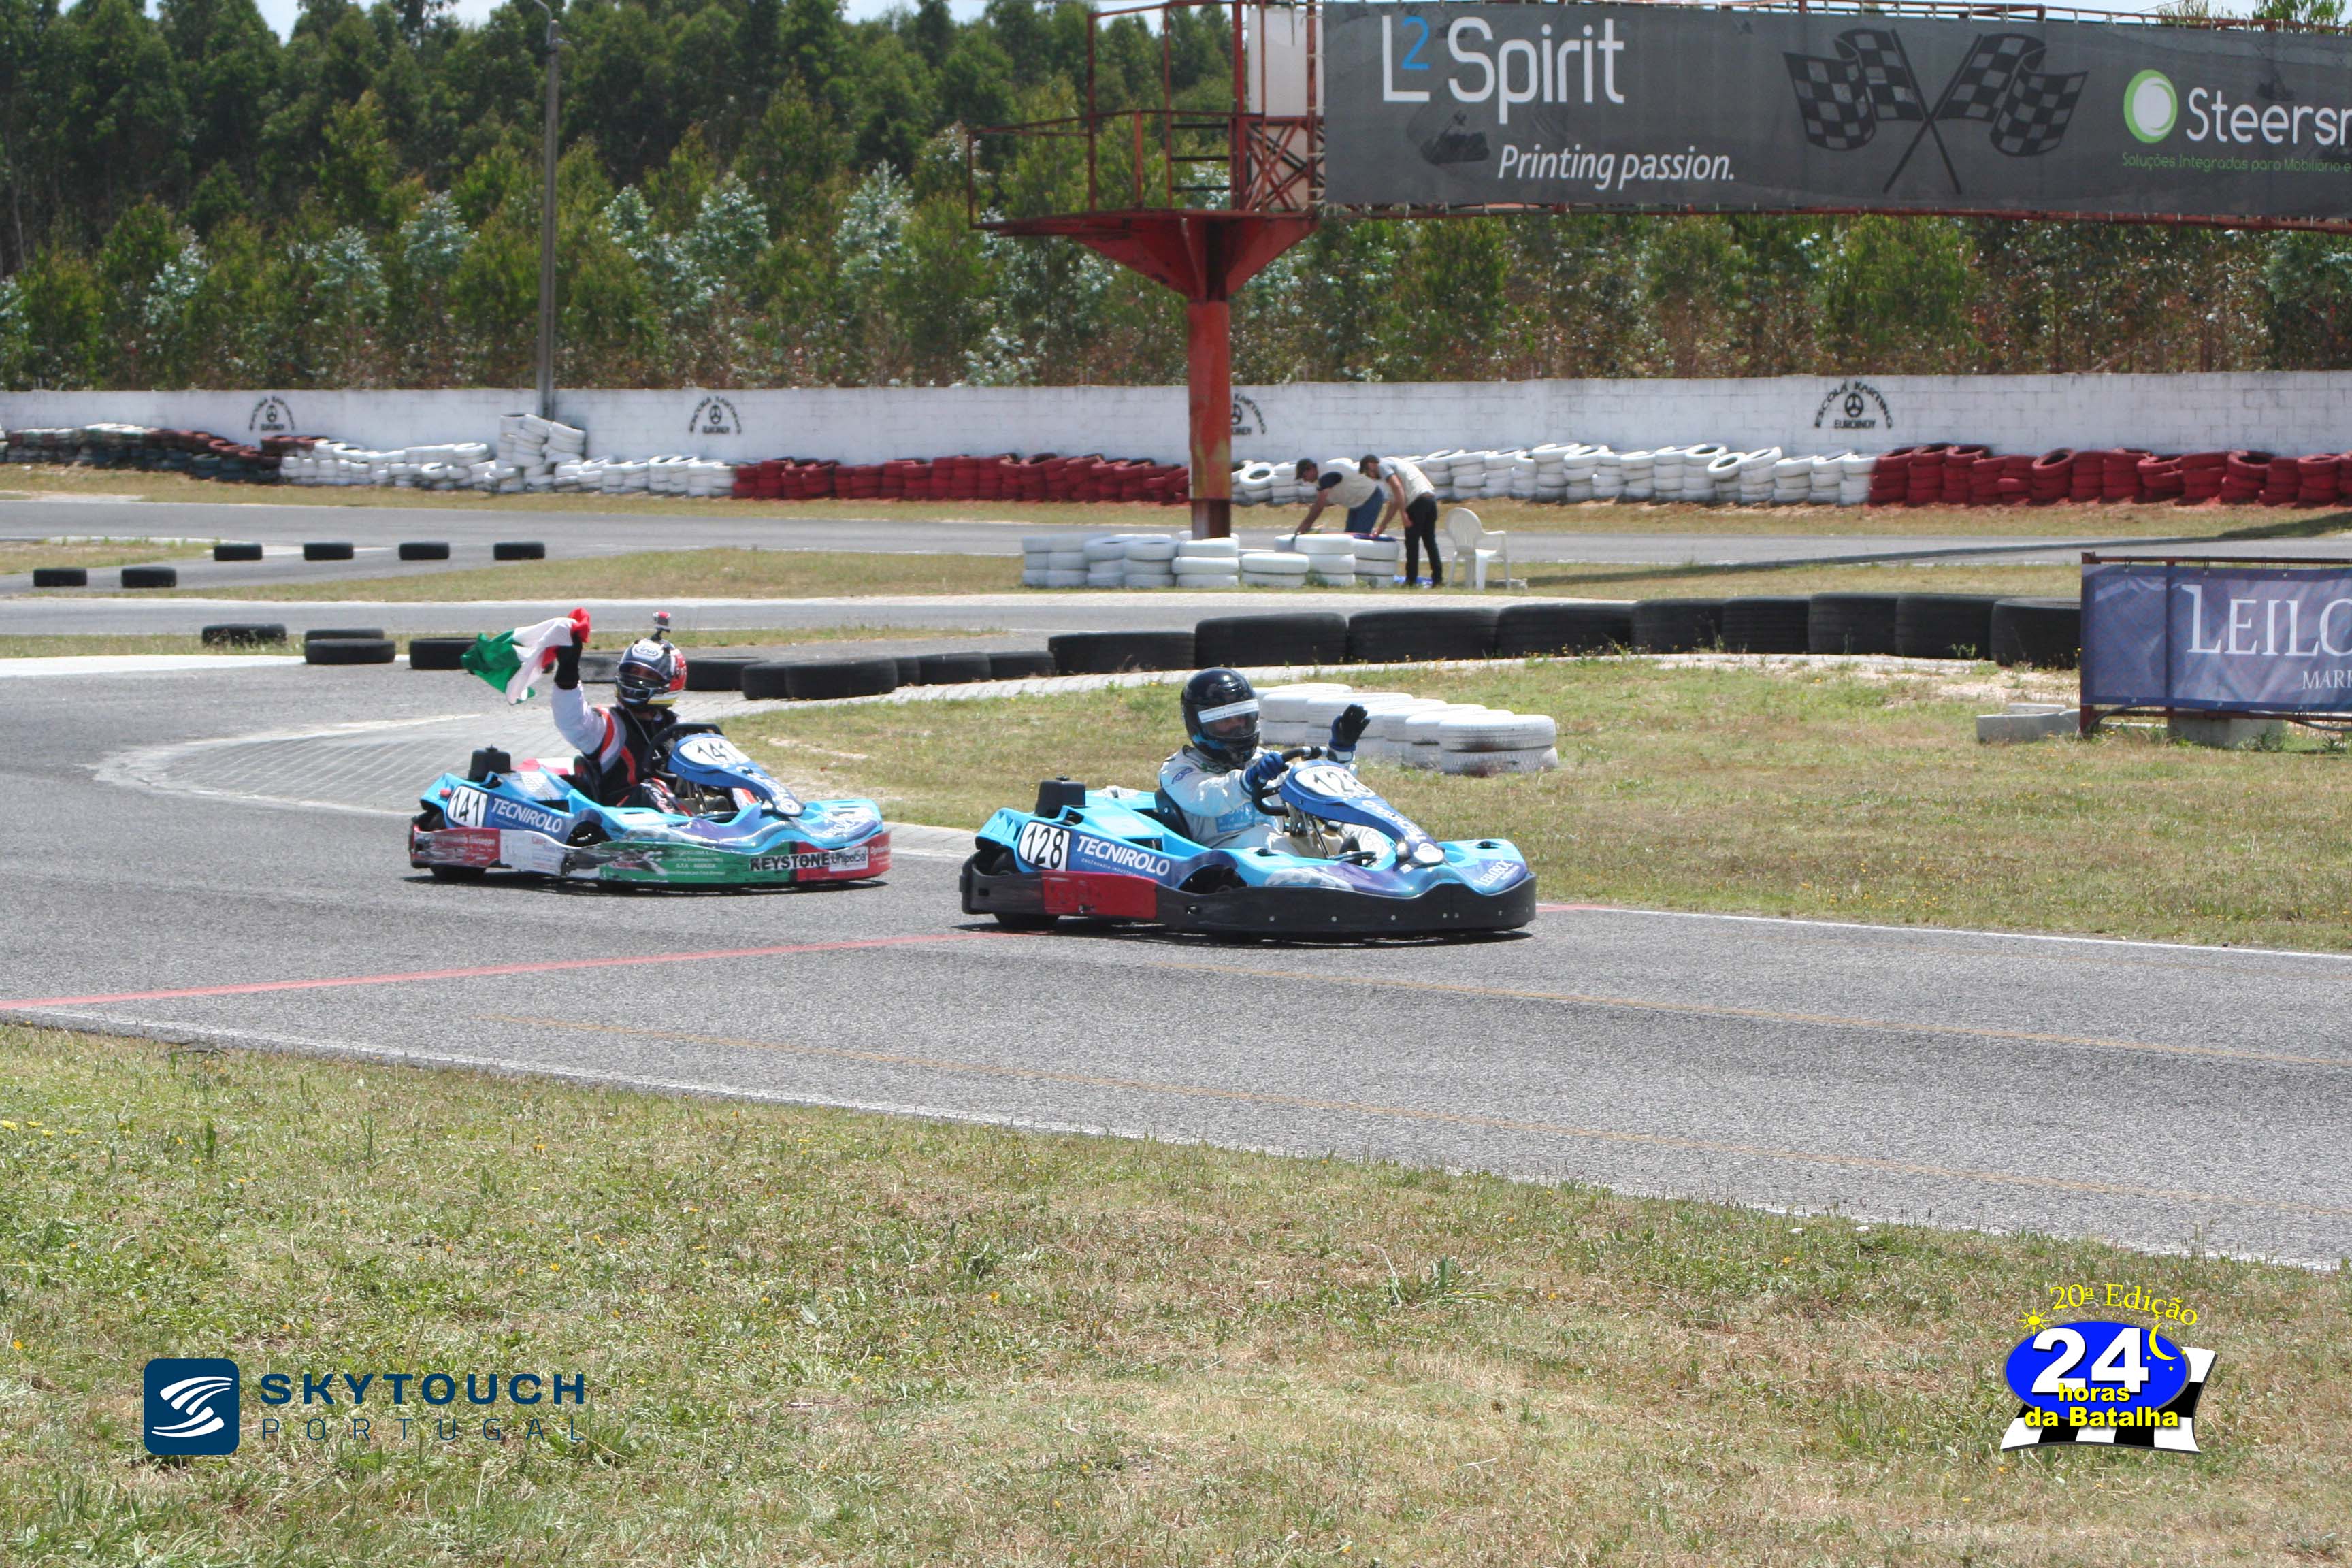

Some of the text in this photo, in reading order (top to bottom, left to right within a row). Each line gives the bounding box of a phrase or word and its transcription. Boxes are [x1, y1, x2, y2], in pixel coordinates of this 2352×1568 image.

[1447, 16, 1625, 125] Spirit
[1498, 144, 1735, 191] Printing passion.
[2122, 152, 2176, 170] Soluções
[2179, 154, 2247, 173] Integradas
[2251, 159, 2281, 173] para
[452, 787, 482, 827] 141
[491, 797, 563, 834] TECNIROLO
[750, 852, 830, 872] KEYSTONE
[1026, 823, 1064, 869] 128
[1076, 834, 1171, 877] TECNIROLO
